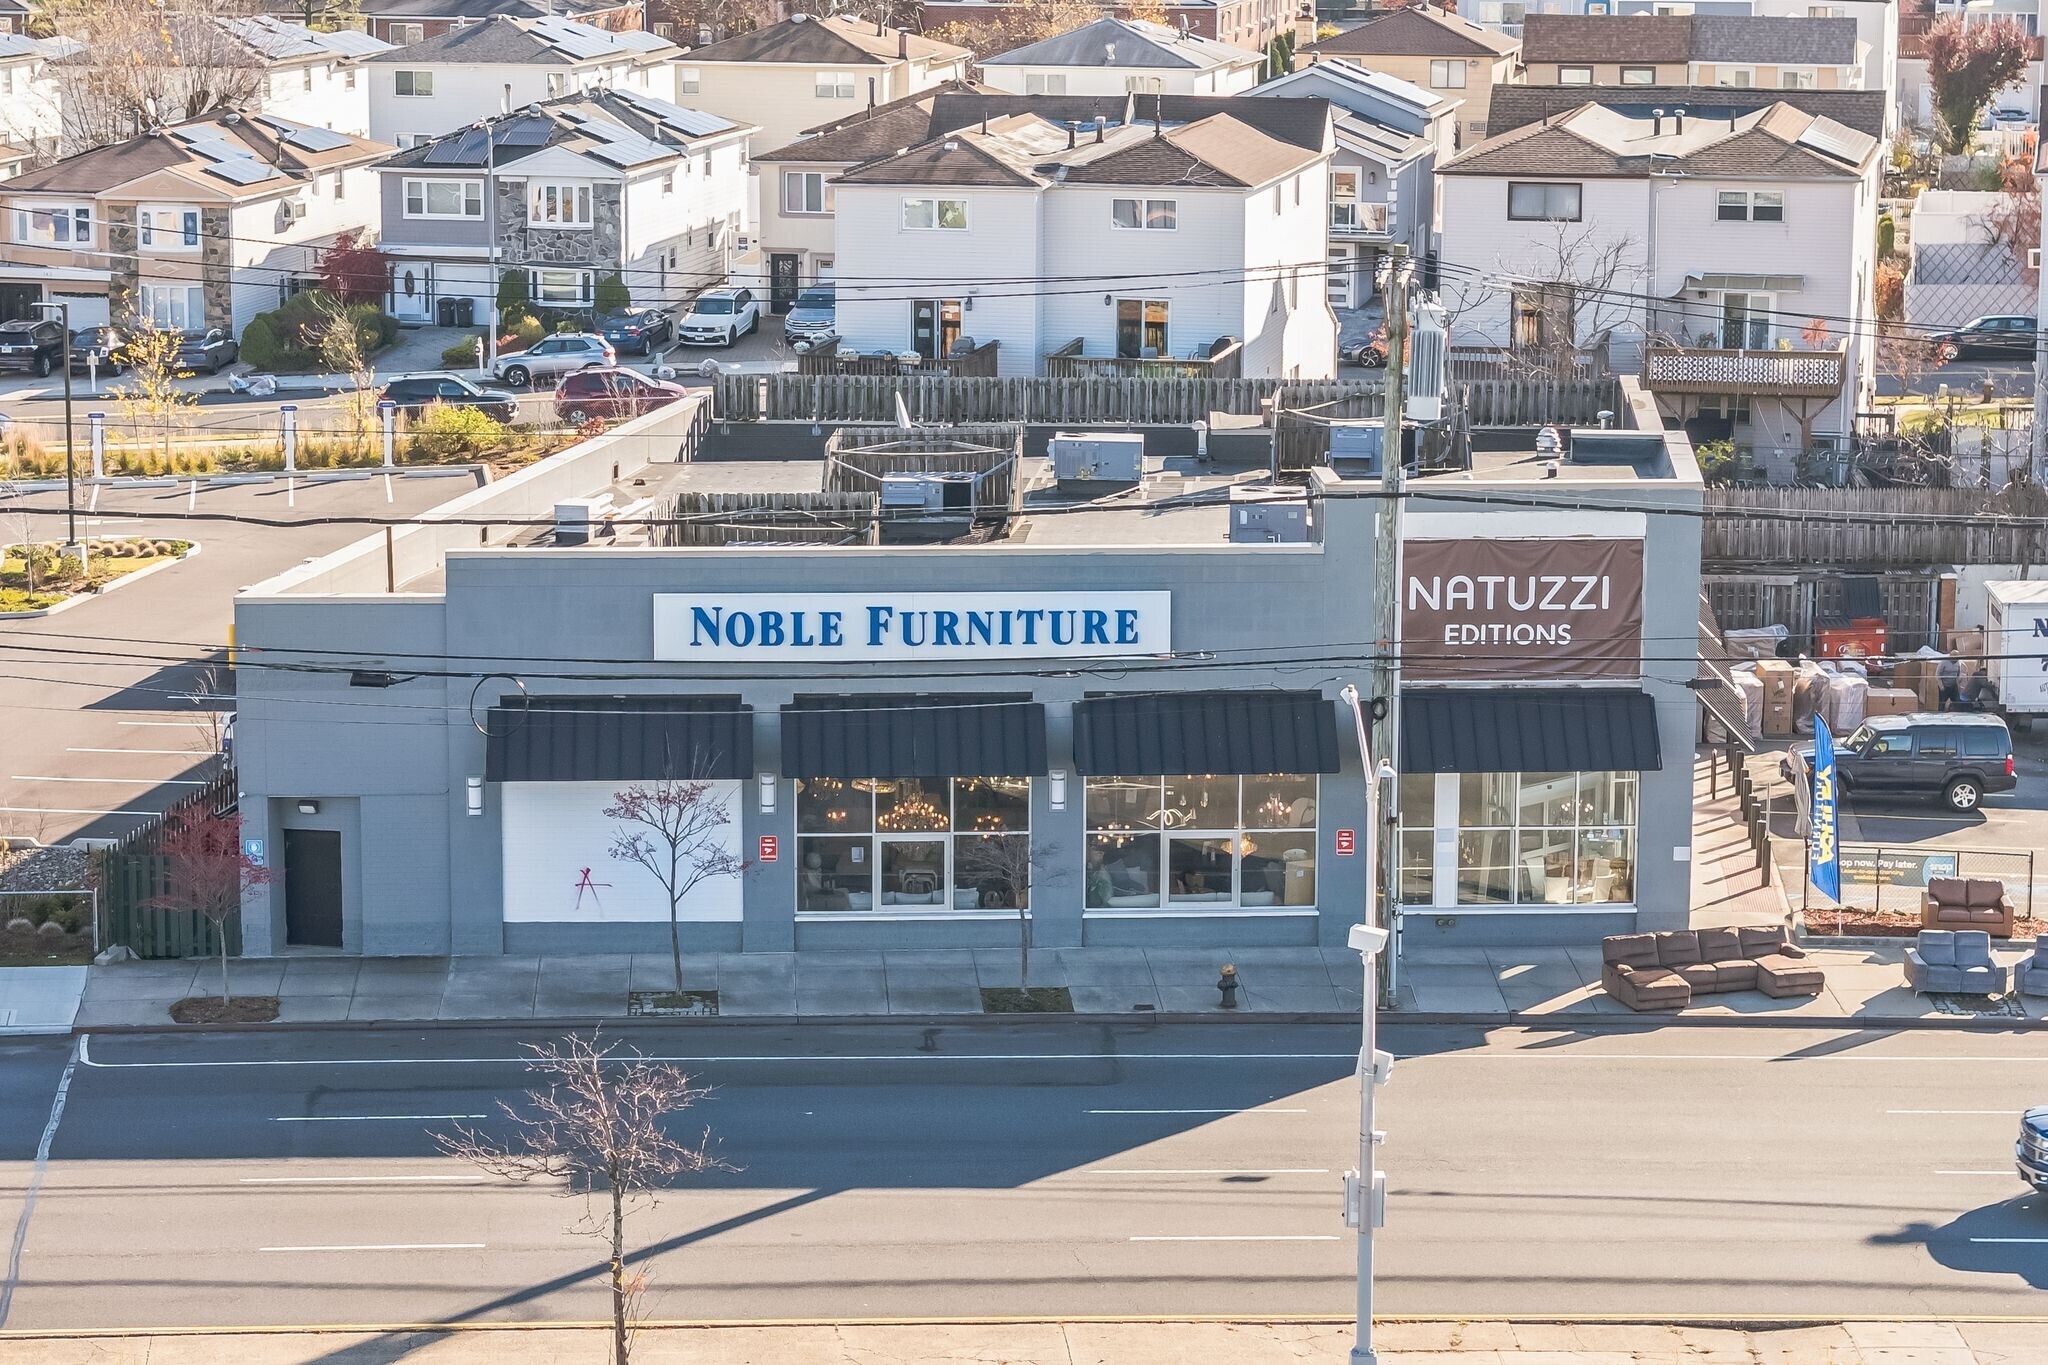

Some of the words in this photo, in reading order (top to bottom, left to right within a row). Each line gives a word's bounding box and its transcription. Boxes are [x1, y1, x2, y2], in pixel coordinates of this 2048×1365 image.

[1408, 575, 1611, 612] NATUZZI
[690, 606, 843, 647] NOBLE
[866, 605, 1139, 646] FURNITURE
[1444, 623, 1572, 646] EDITIONS
[1878, 859, 1894, 869] Pay
[1895, 860, 1918, 869] later.
